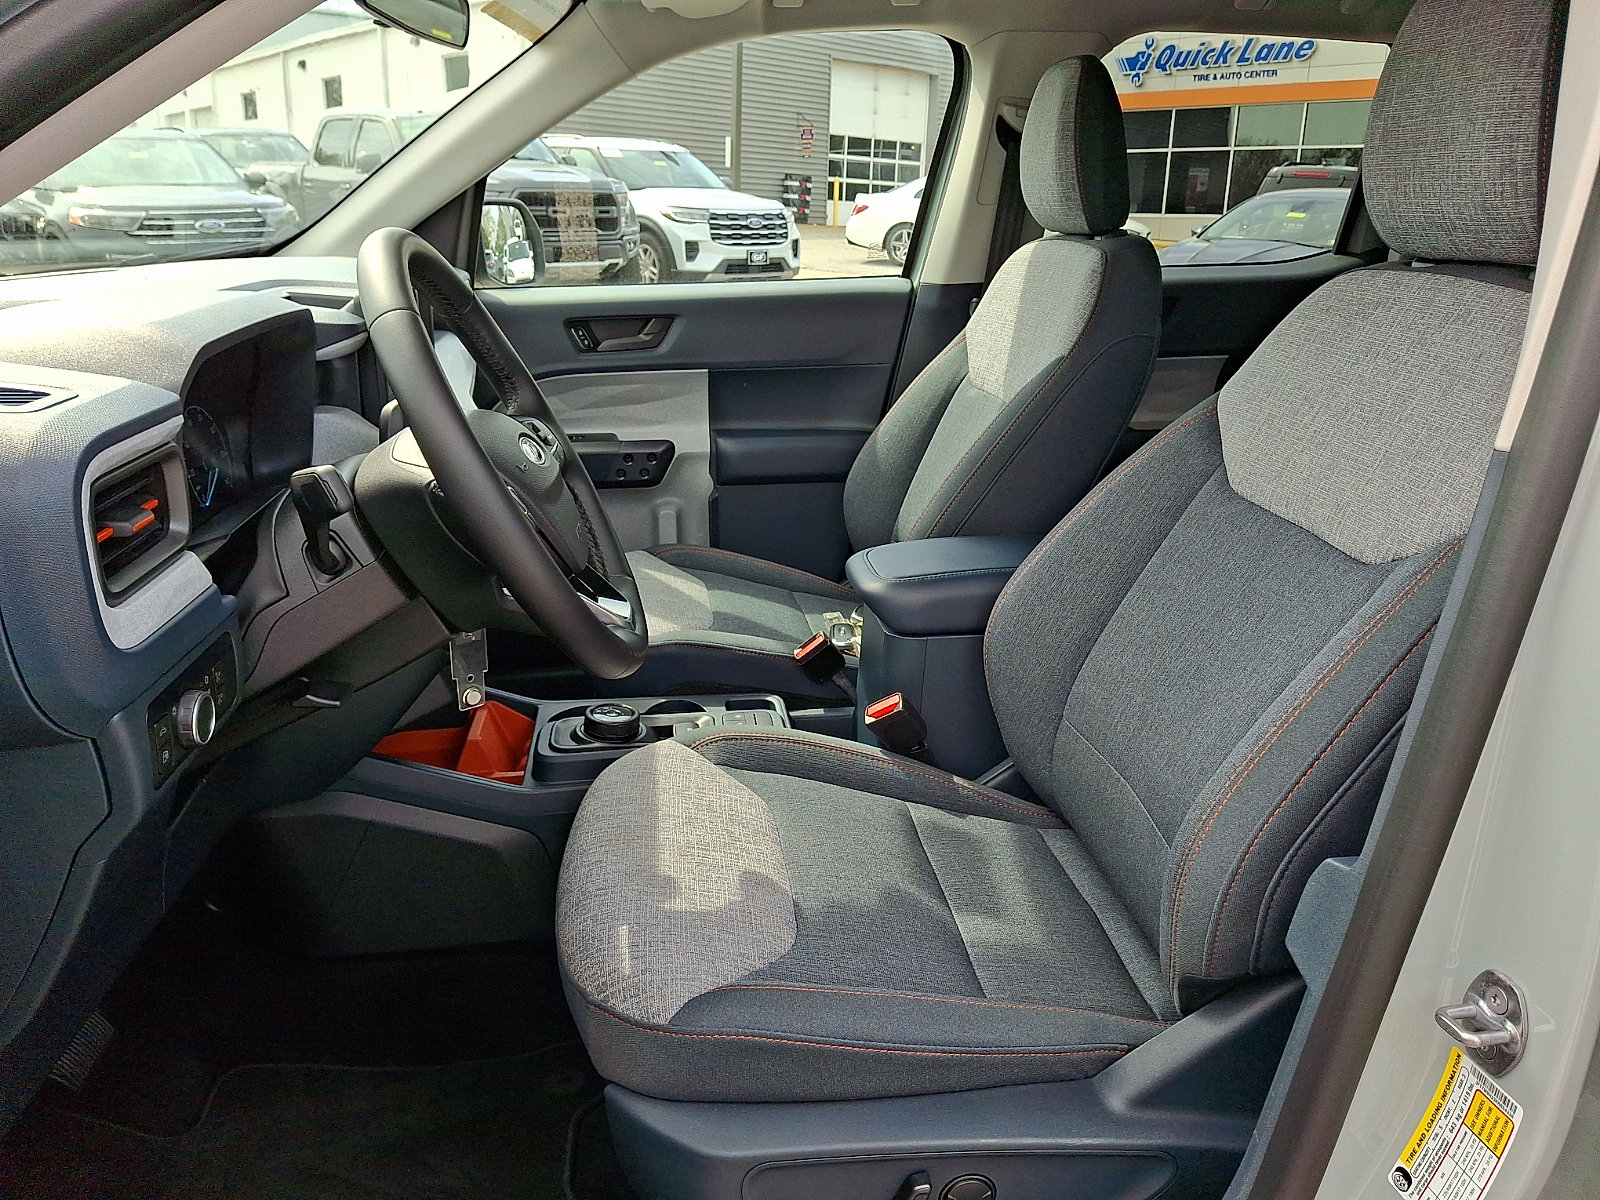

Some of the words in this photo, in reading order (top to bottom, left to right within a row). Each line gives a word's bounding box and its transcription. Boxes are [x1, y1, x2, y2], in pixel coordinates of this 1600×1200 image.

[1154, 40, 1235, 74] Quick
[1236, 38, 1316, 65] Lane
[1193, 74, 1210, 82] TIRE
[1212, 73, 1217, 81] &
[1219, 72, 1242, 81] AUTO
[1244, 70, 1277, 79] CENTER
[1405, 1148, 1418, 1164] TIRE
[1417, 1133, 1427, 1148] AND
[1426, 1102, 1442, 1132] LOADING
[1441, 1053, 1462, 1102] INFORMATION
[1448, 1121, 1457, 1134] 643
[1455, 1112, 1462, 1122] kg
[1462, 1090, 1470, 1106] 1419
[1469, 1118, 1477, 1130] SEE
[1474, 1099, 1486, 1120] OWNERS
[1477, 1116, 1489, 1137] MANUAL
[1485, 1115, 1500, 1143] ADDITIONAL
[1492, 1118, 1509, 1153] INFORMATION
